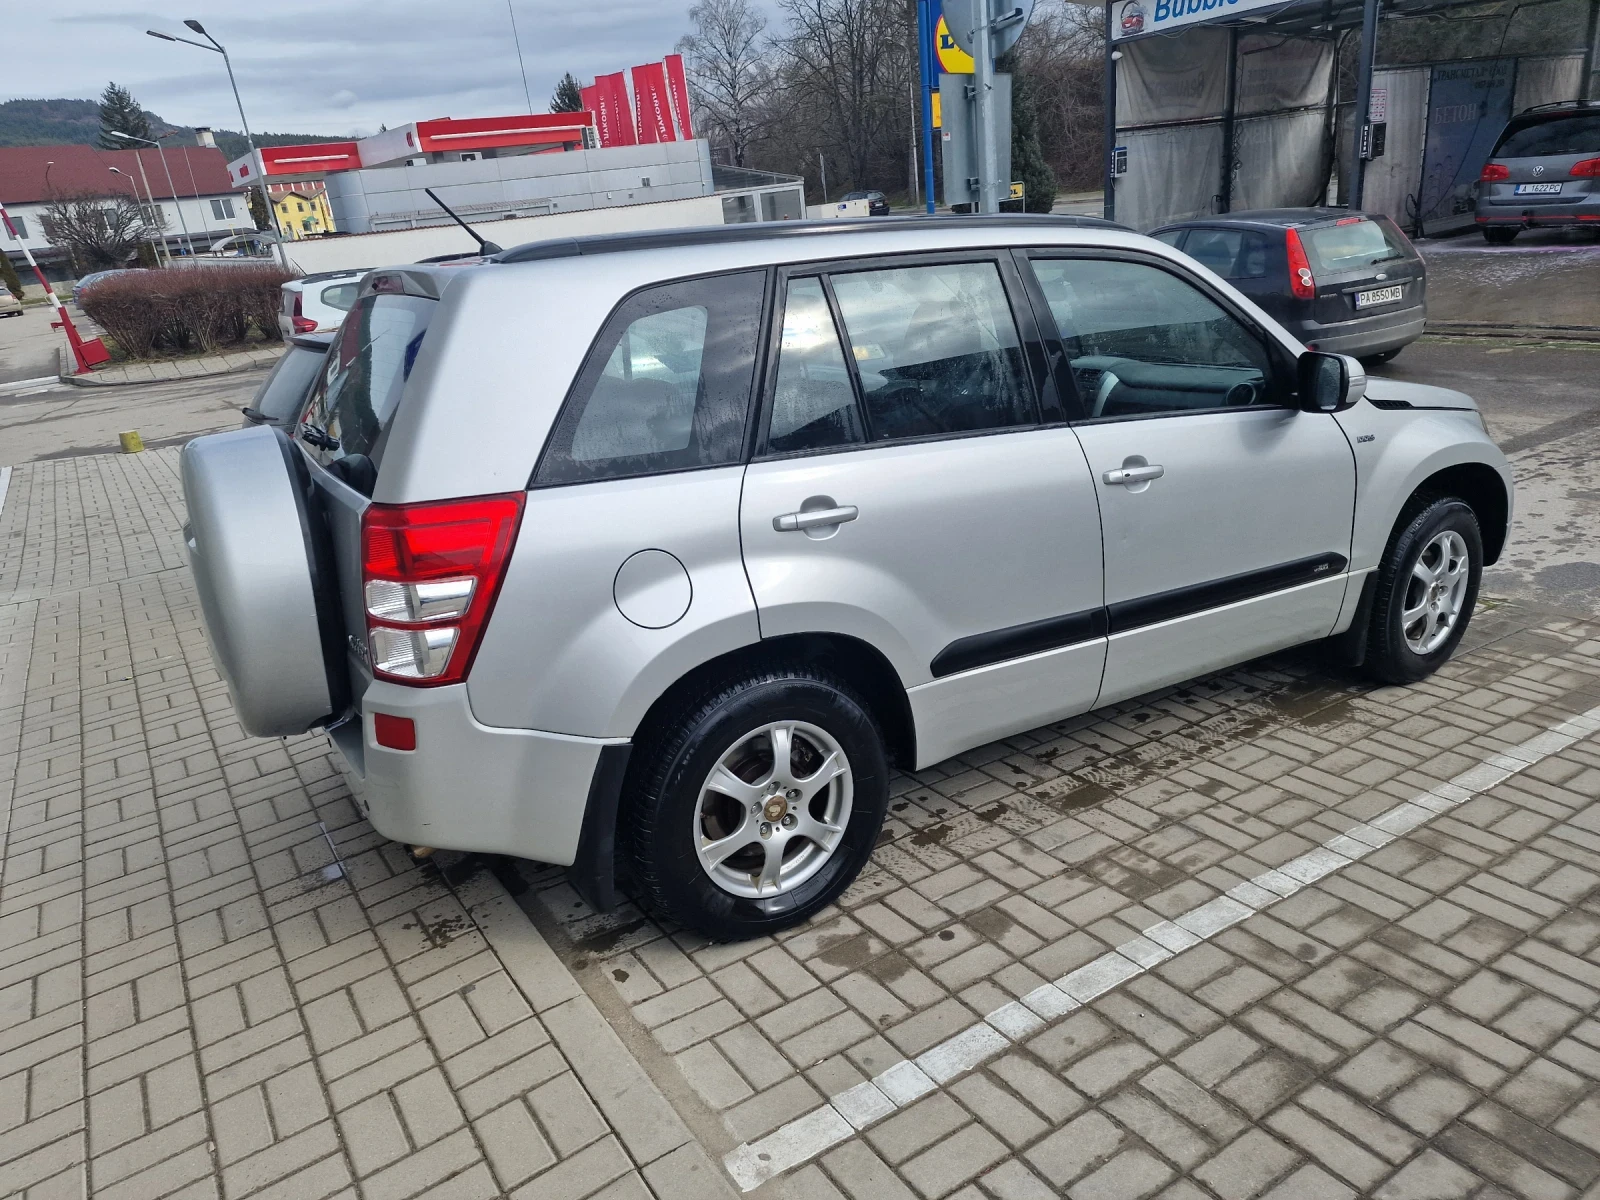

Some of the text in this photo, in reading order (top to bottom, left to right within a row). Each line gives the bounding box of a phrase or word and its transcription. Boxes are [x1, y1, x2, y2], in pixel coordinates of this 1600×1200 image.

[1434, 103, 1476, 125] БЕТОН
[1360, 293, 1371, 304] PA
[1371, 290, 1390, 302] 8550
